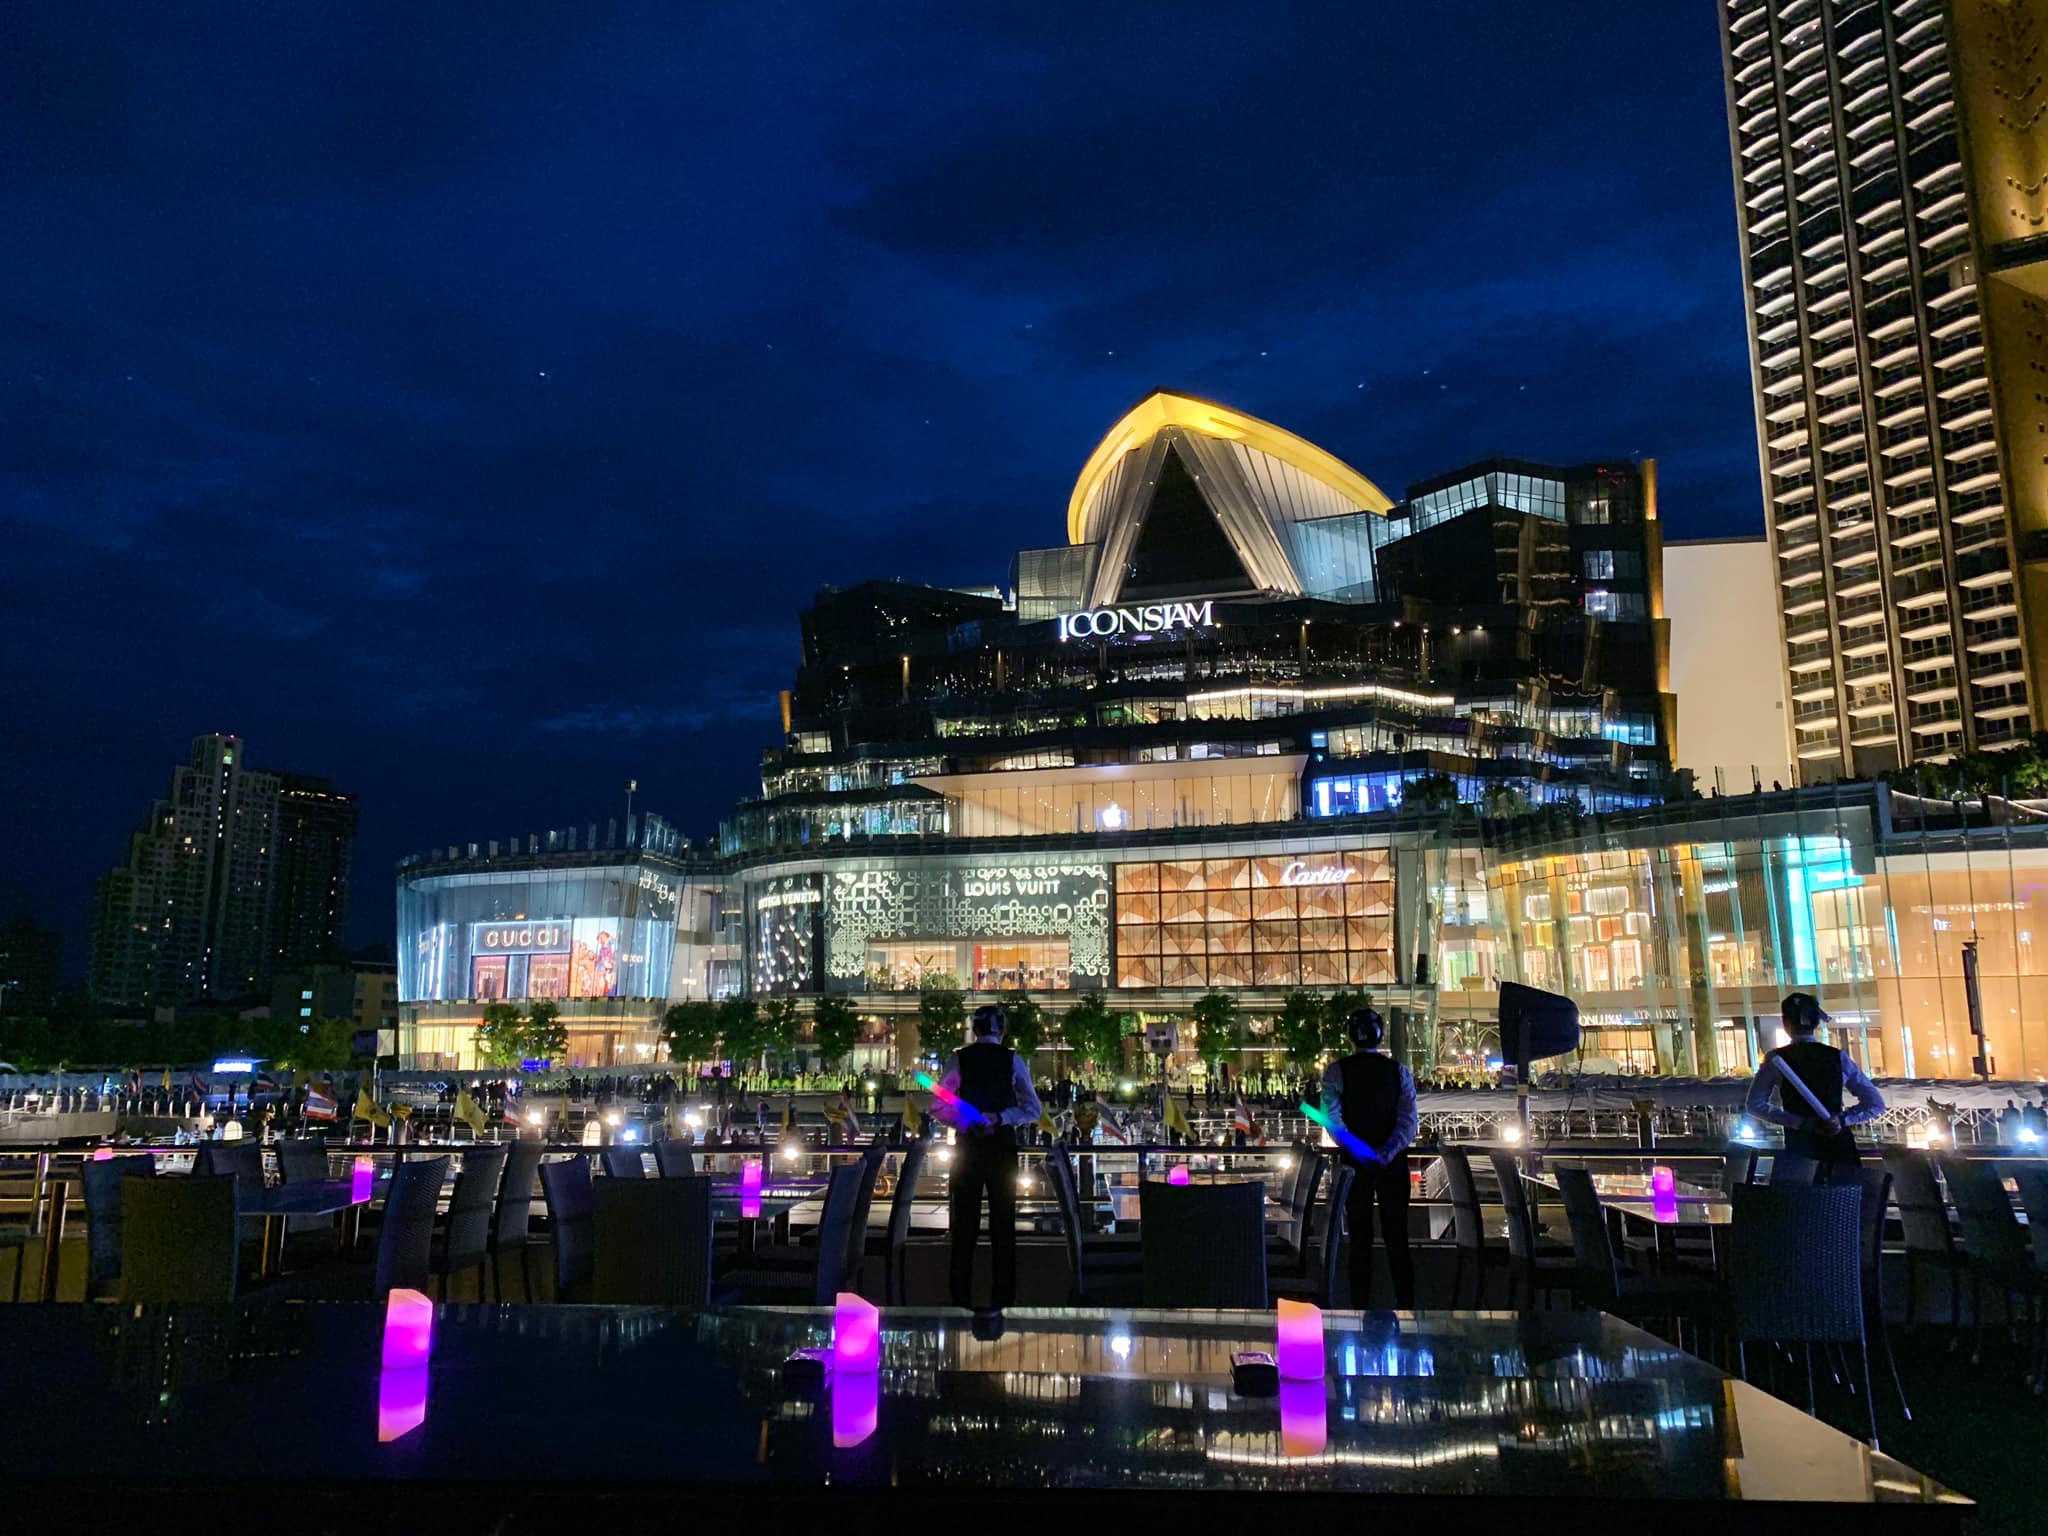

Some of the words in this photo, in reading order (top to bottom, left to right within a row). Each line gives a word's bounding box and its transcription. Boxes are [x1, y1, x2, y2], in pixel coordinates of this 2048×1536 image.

[1057, 601, 1214, 640] ICONSIAM
[1281, 862, 1355, 886] Cartier
[964, 881, 1011, 896] LOUIS
[485, 928, 560, 948] GUCCI
